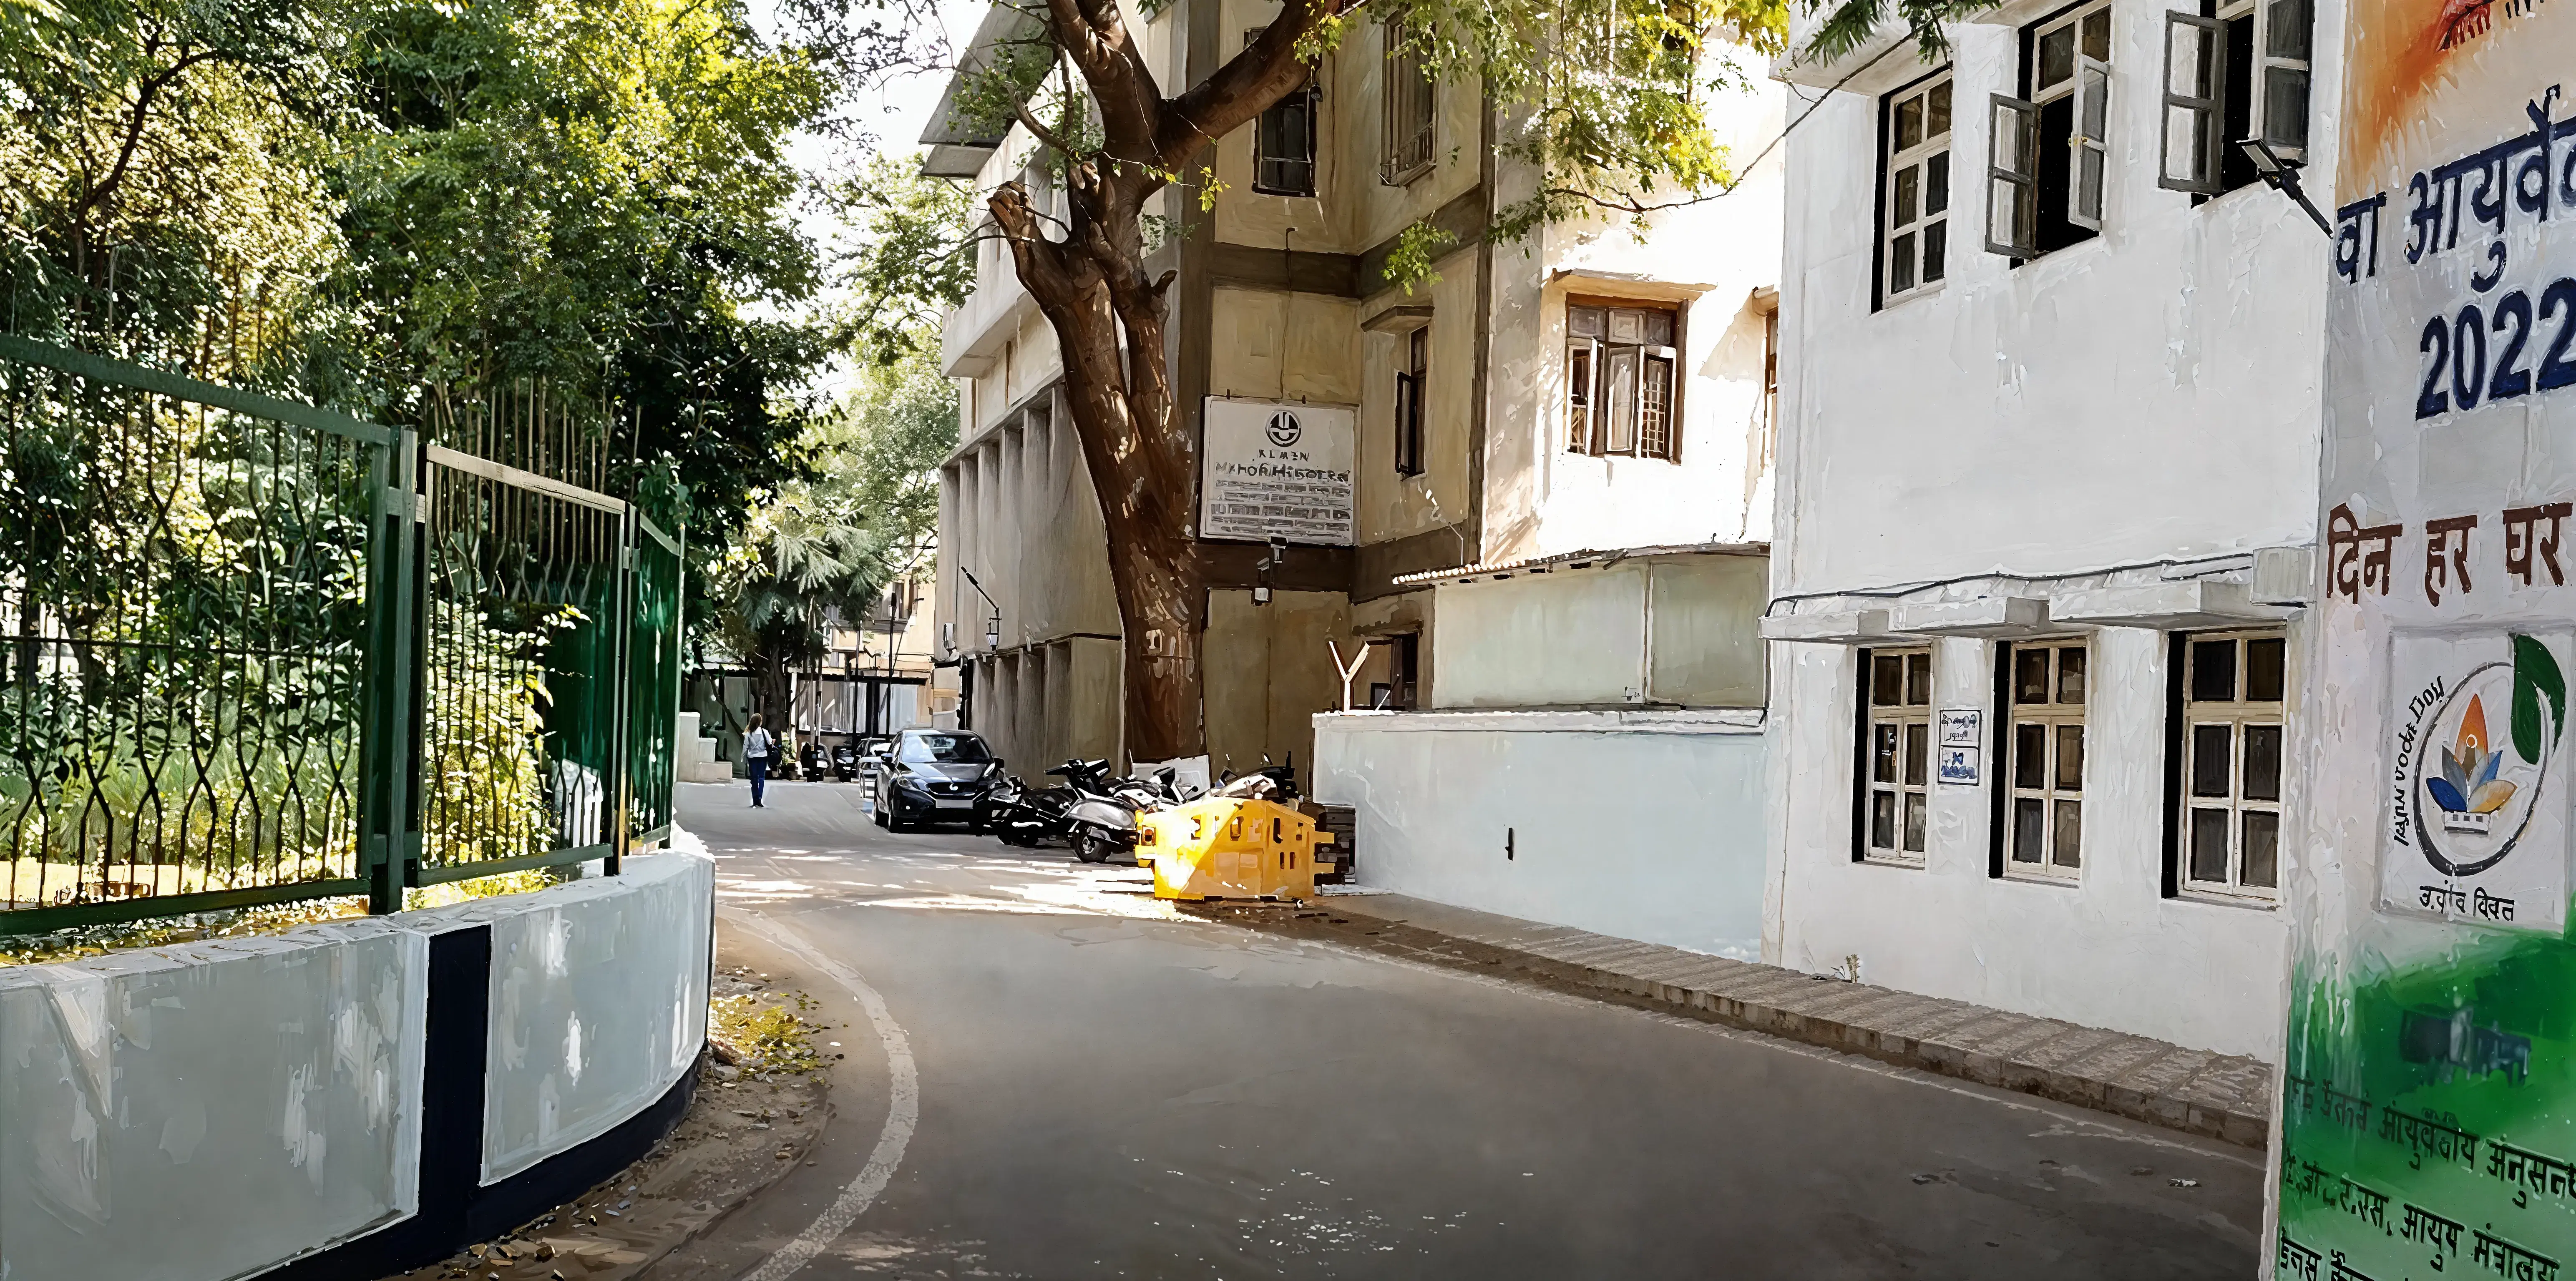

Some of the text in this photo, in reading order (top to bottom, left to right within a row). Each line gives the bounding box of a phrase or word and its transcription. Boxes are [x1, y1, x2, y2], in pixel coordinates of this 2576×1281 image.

[2415, 277, 2576, 421] 2022
[2327, 502, 2573, 607] दिन हर घर
